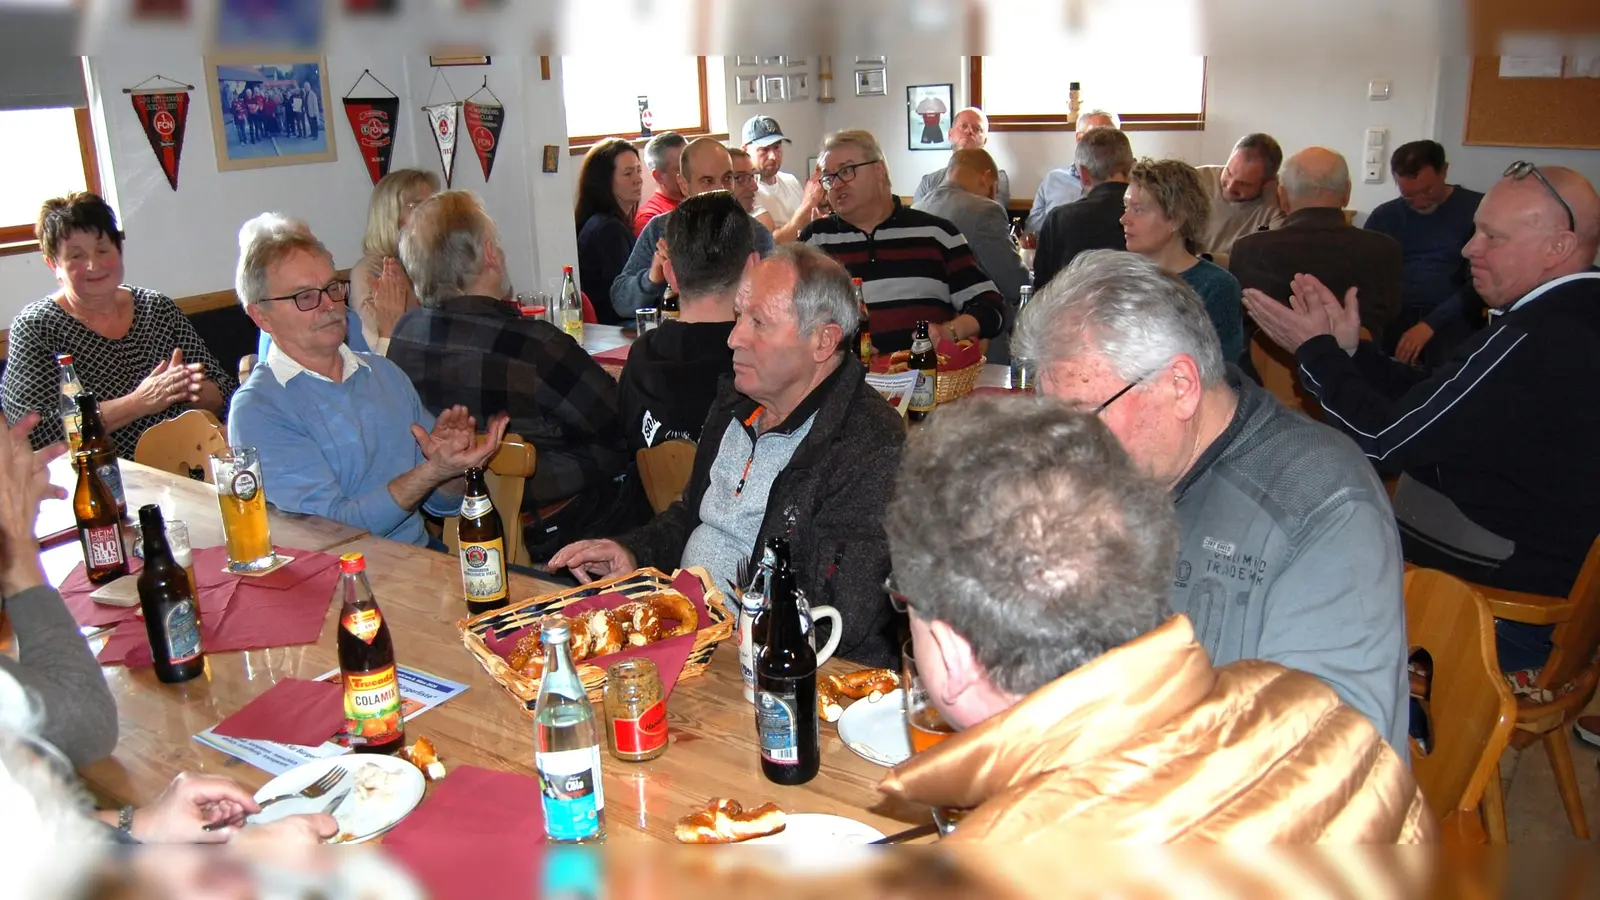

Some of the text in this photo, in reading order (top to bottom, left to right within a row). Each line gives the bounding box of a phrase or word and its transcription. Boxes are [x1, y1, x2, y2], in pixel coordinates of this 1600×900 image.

[156, 121, 173, 130] FCN
[90, 529, 114, 538] HEIM
[92, 540, 117, 553] SUD
[352, 673, 393, 688] Trucade
[355, 688, 396, 706] COLAMIX
[566, 781, 584, 791] Cola
